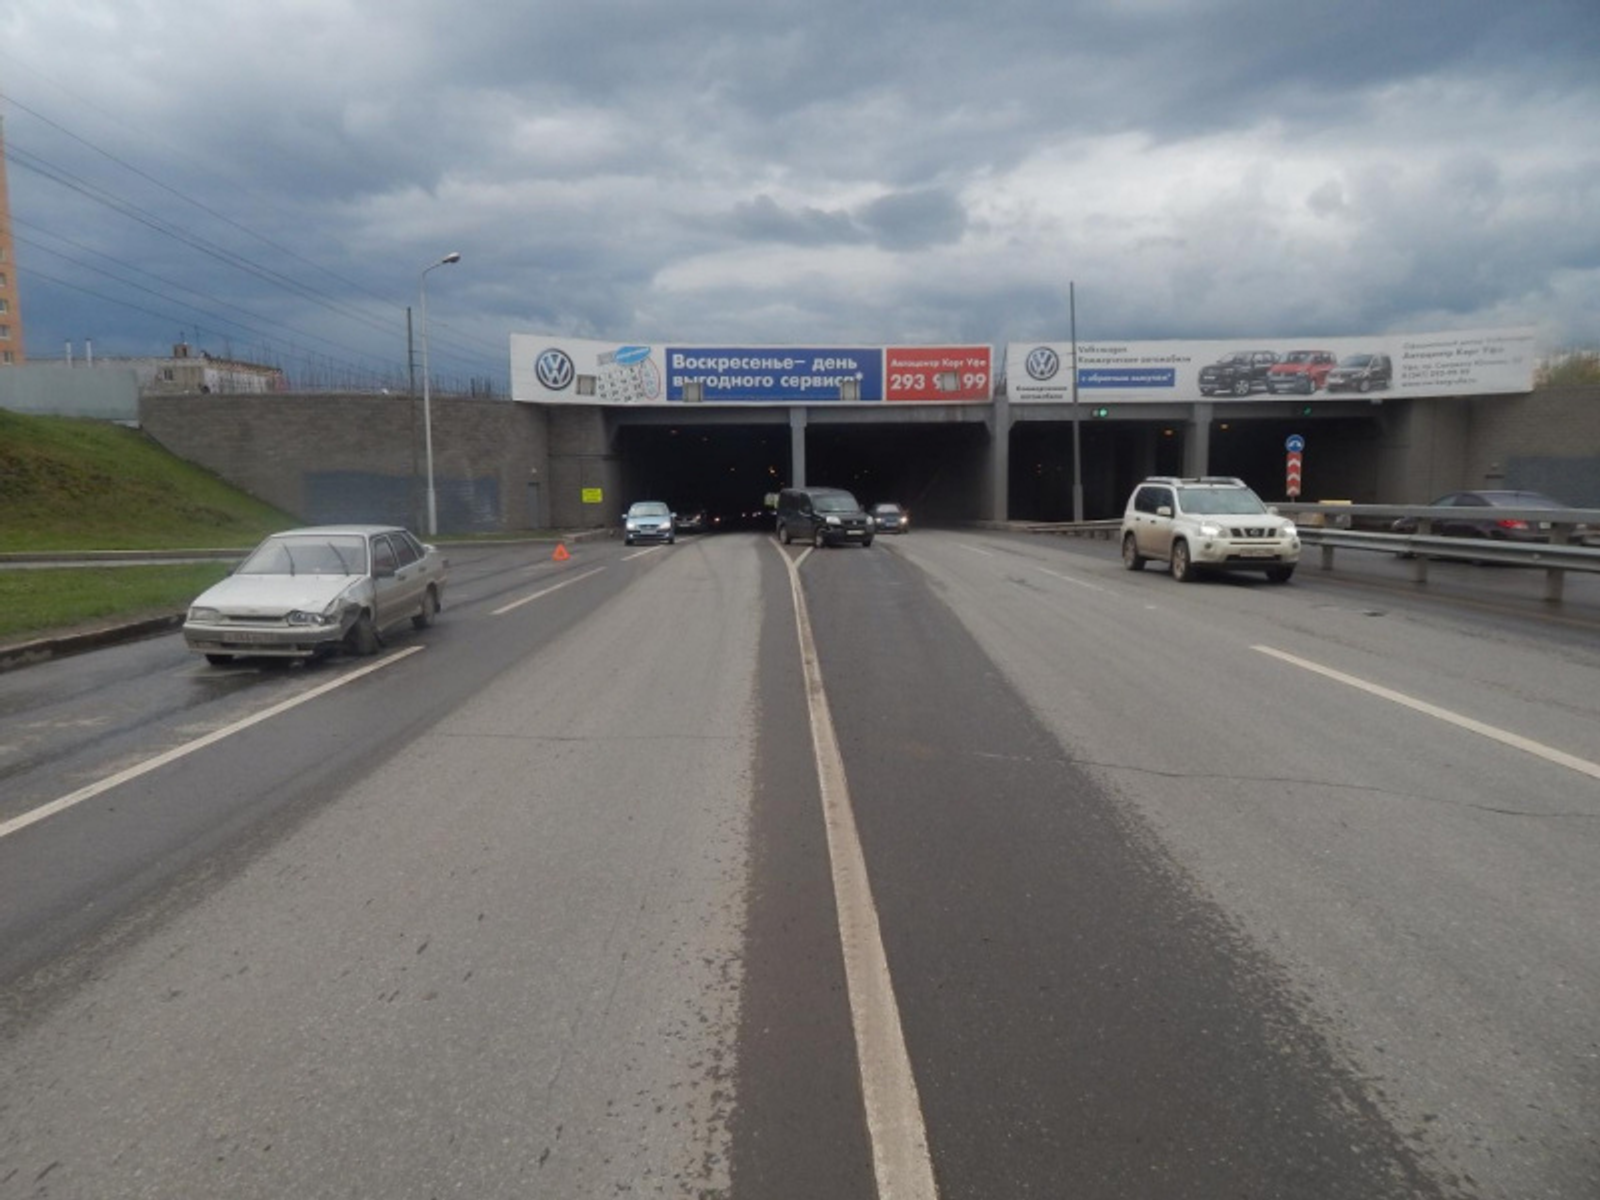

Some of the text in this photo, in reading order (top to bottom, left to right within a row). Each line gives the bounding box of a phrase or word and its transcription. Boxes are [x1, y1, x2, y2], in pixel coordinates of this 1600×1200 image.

[811, 357, 858, 371] день
[672, 375, 774, 389] выгодного
[890, 373, 925, 390] 293
[963, 372, 987, 390] 99
